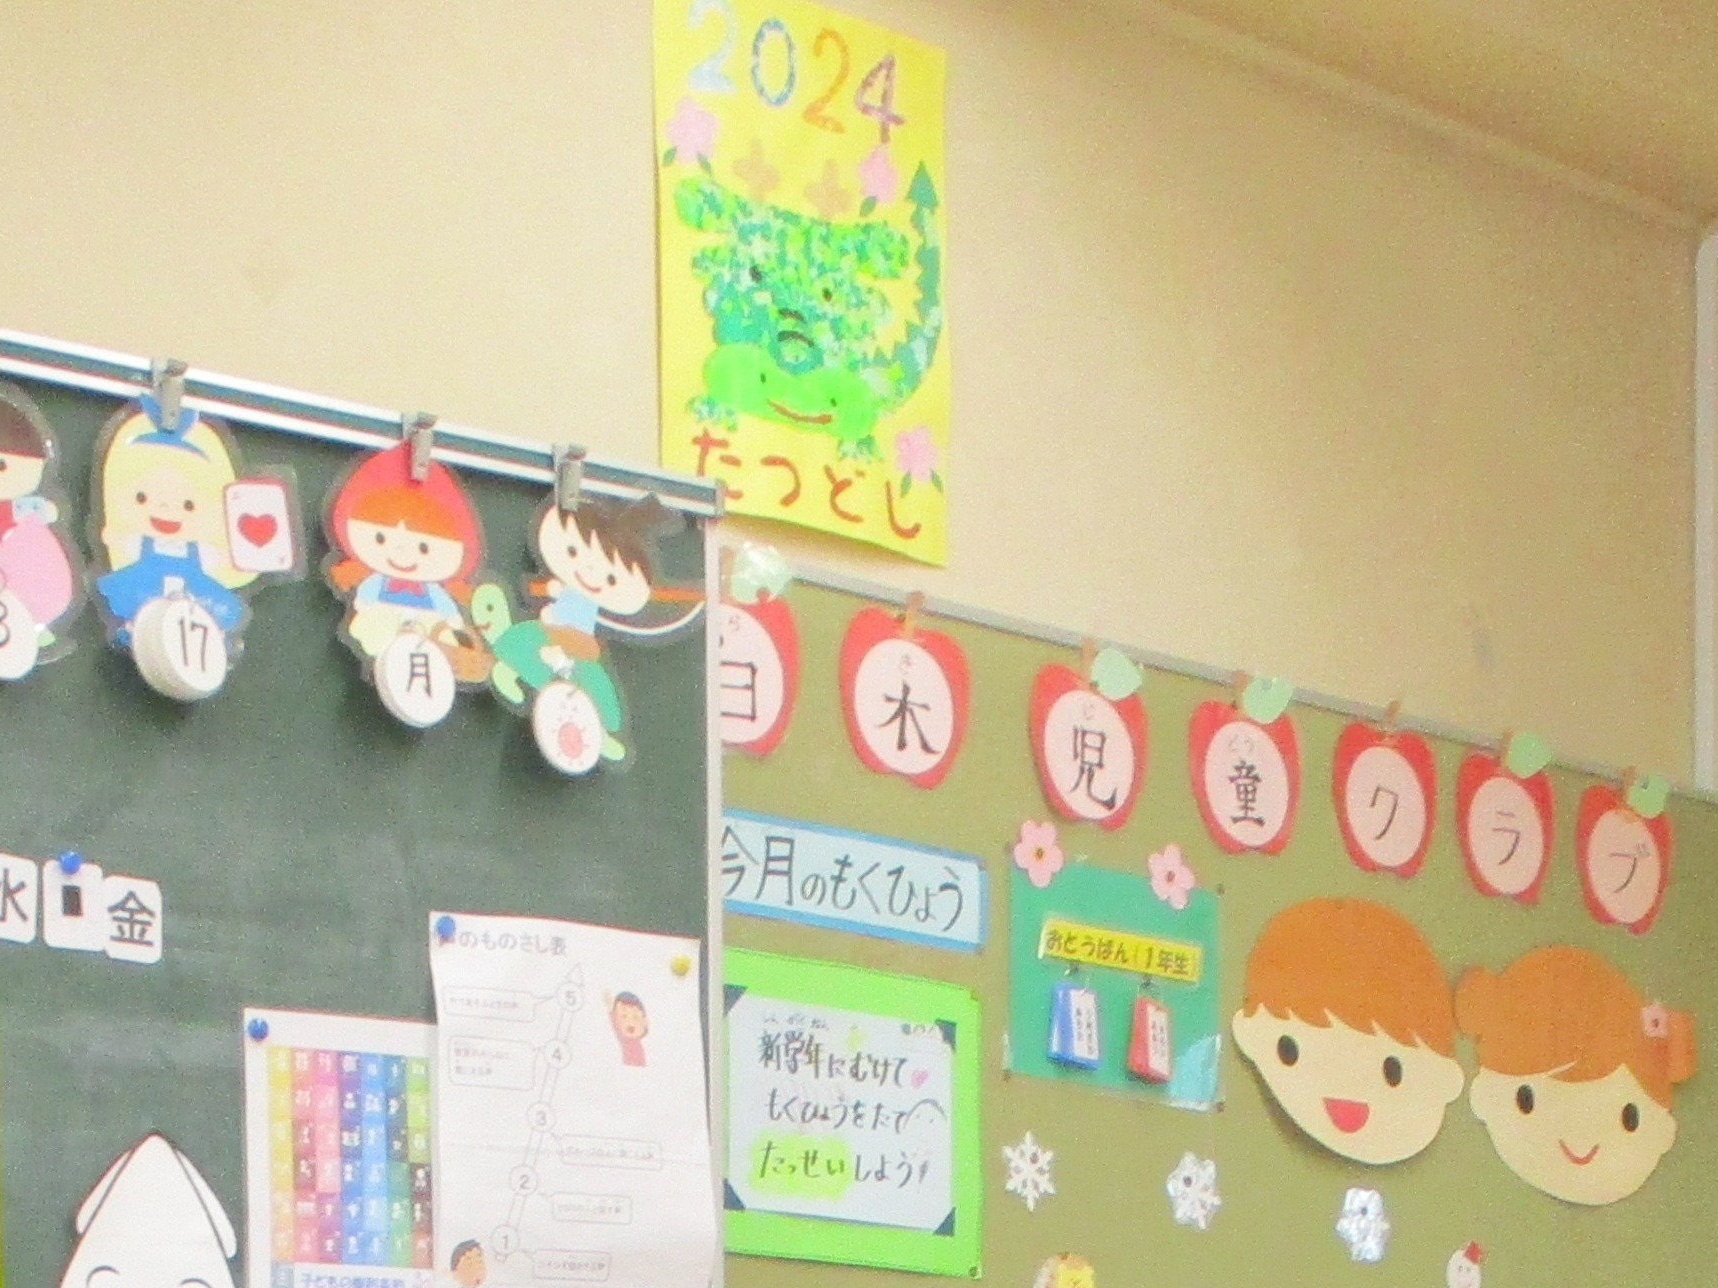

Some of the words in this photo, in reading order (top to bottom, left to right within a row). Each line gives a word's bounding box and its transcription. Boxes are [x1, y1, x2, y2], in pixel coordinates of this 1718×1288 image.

[686, 0, 905, 144] 2024
[692, 428, 922, 539] たつどし
[178, 620, 209, 674] 17
[405, 652, 435, 700] 月
[722, 825, 964, 932] 今月のもくひょう
[107, 890, 156, 948] 金
[437, 930, 567, 956] のものさし表
[565, 989, 579, 1005] 5
[549, 1046, 563, 1063] 4
[535, 1110, 549, 1127] 3
[519, 1174, 531, 1191] 2
[501, 1235, 510, 1250] 1
